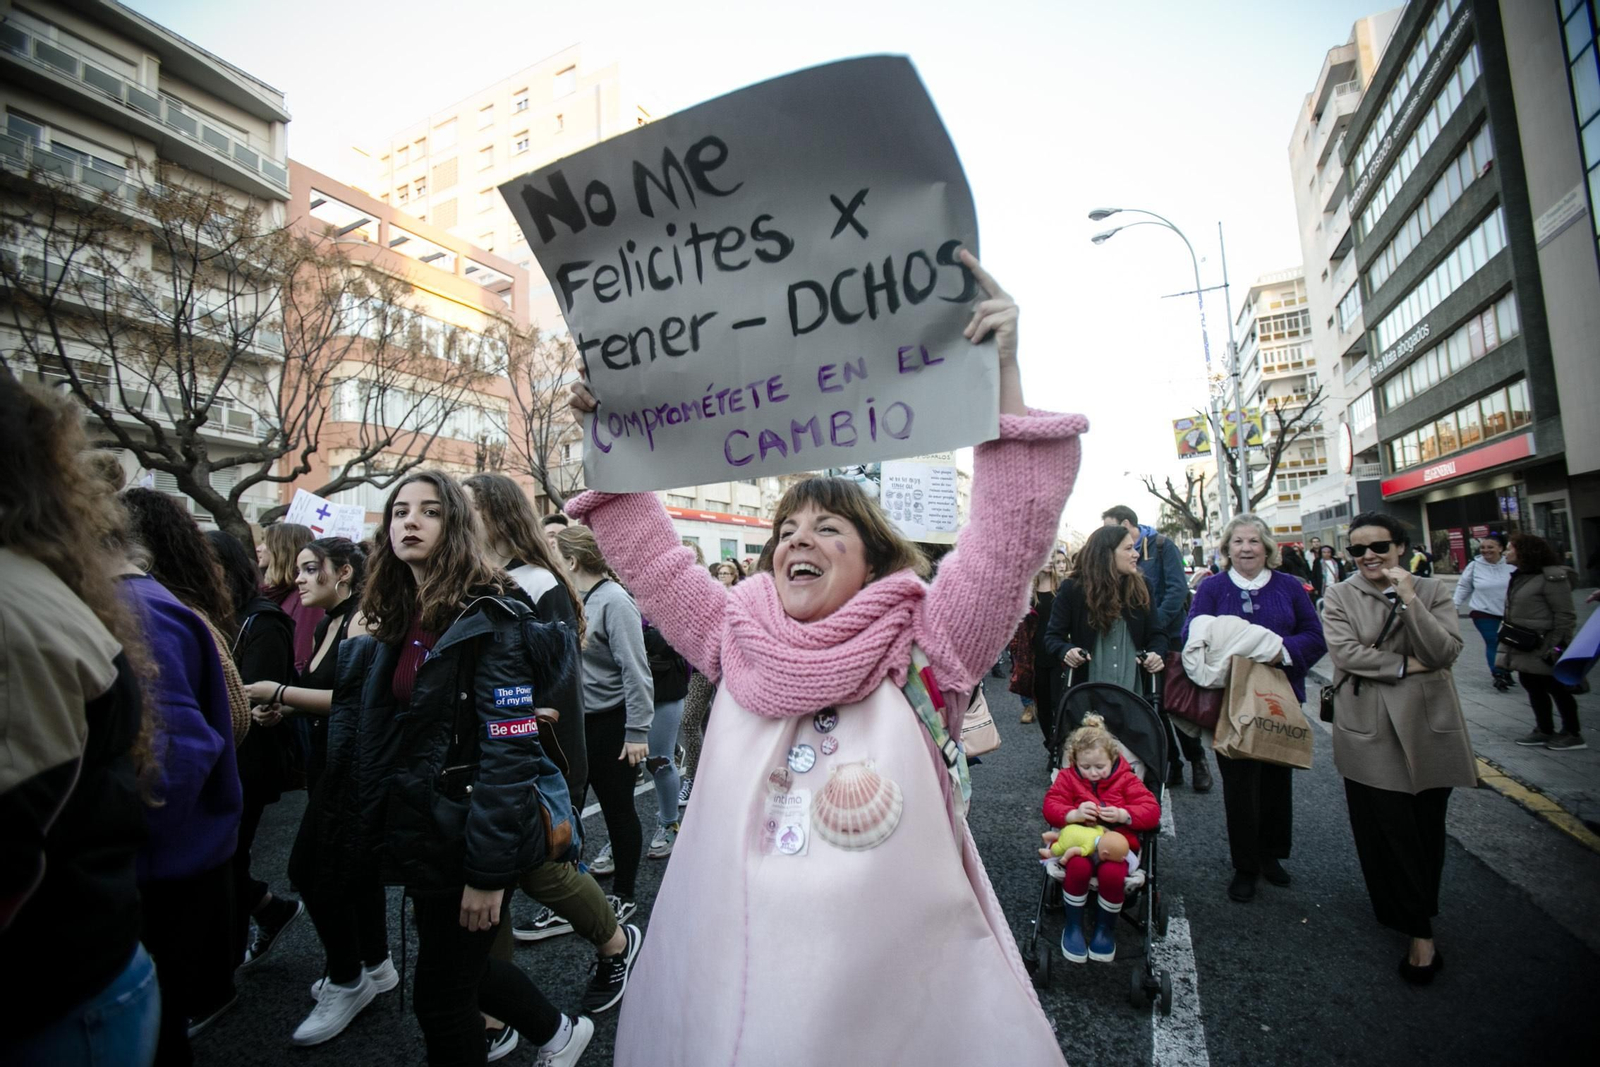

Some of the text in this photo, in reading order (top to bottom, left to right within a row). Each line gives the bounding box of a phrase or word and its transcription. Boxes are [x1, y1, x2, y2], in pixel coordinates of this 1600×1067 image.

[1368, 136, 1392, 179] rosado
[520, 170, 617, 244] No
[556, 214, 794, 314] Felicites
[577, 312, 719, 382] tener
[787, 239, 979, 337] DCHOS
[1397, 323, 1430, 353] abogados
[818, 356, 868, 393] EN
[898, 344, 945, 374] EL
[495, 697, 506, 705] of
[507, 697, 520, 706] my
[498, 688, 514, 696] The
[489, 724, 508, 736] Be
[1238, 715, 1309, 741] CATCHALOT
